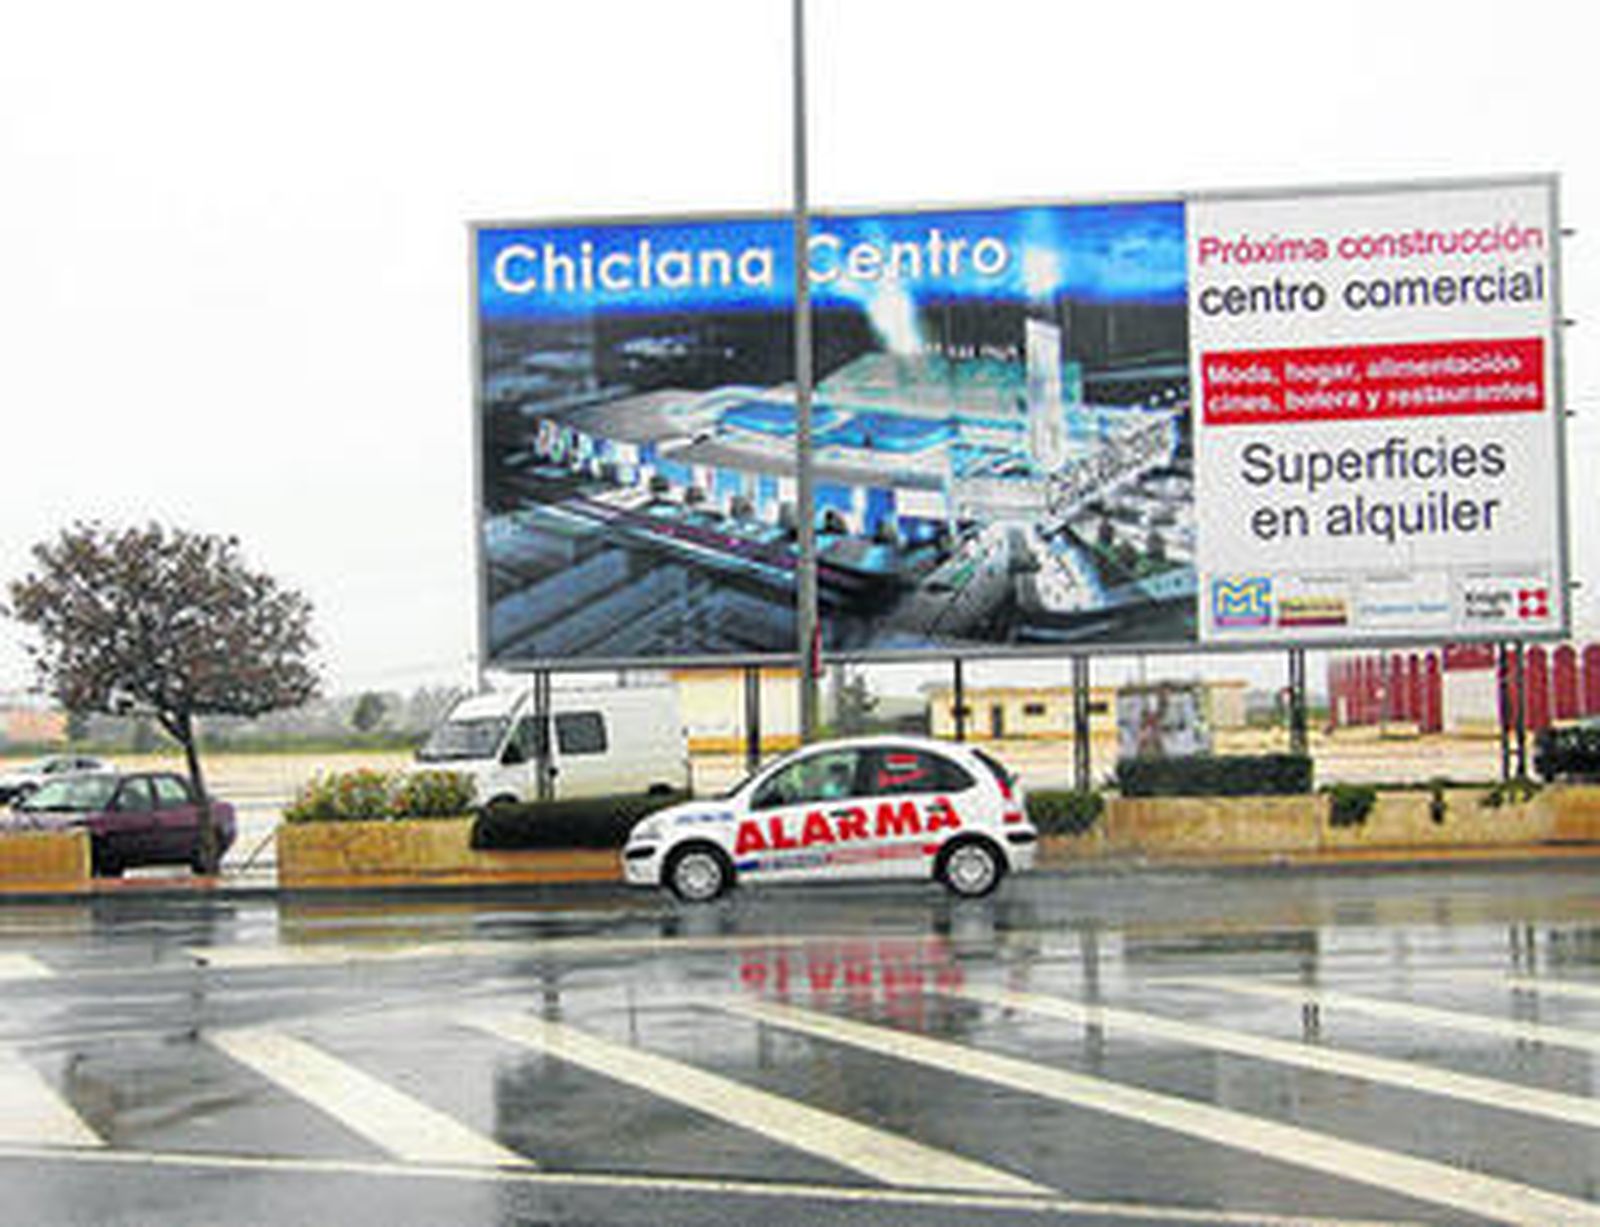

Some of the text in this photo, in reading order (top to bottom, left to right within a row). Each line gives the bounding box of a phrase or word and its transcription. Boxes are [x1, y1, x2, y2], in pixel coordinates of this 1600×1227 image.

[493, 227, 1009, 293] Chiclana Centro
[1198, 221, 1543, 266] Próxima construcción
[1200, 264, 1544, 316] centro comercial
[1366, 391, 1381, 411] y
[1241, 436, 1506, 491] Superficies
[1251, 491, 1500, 544] en alquiler
[735, 796, 961, 856] ALARMA
